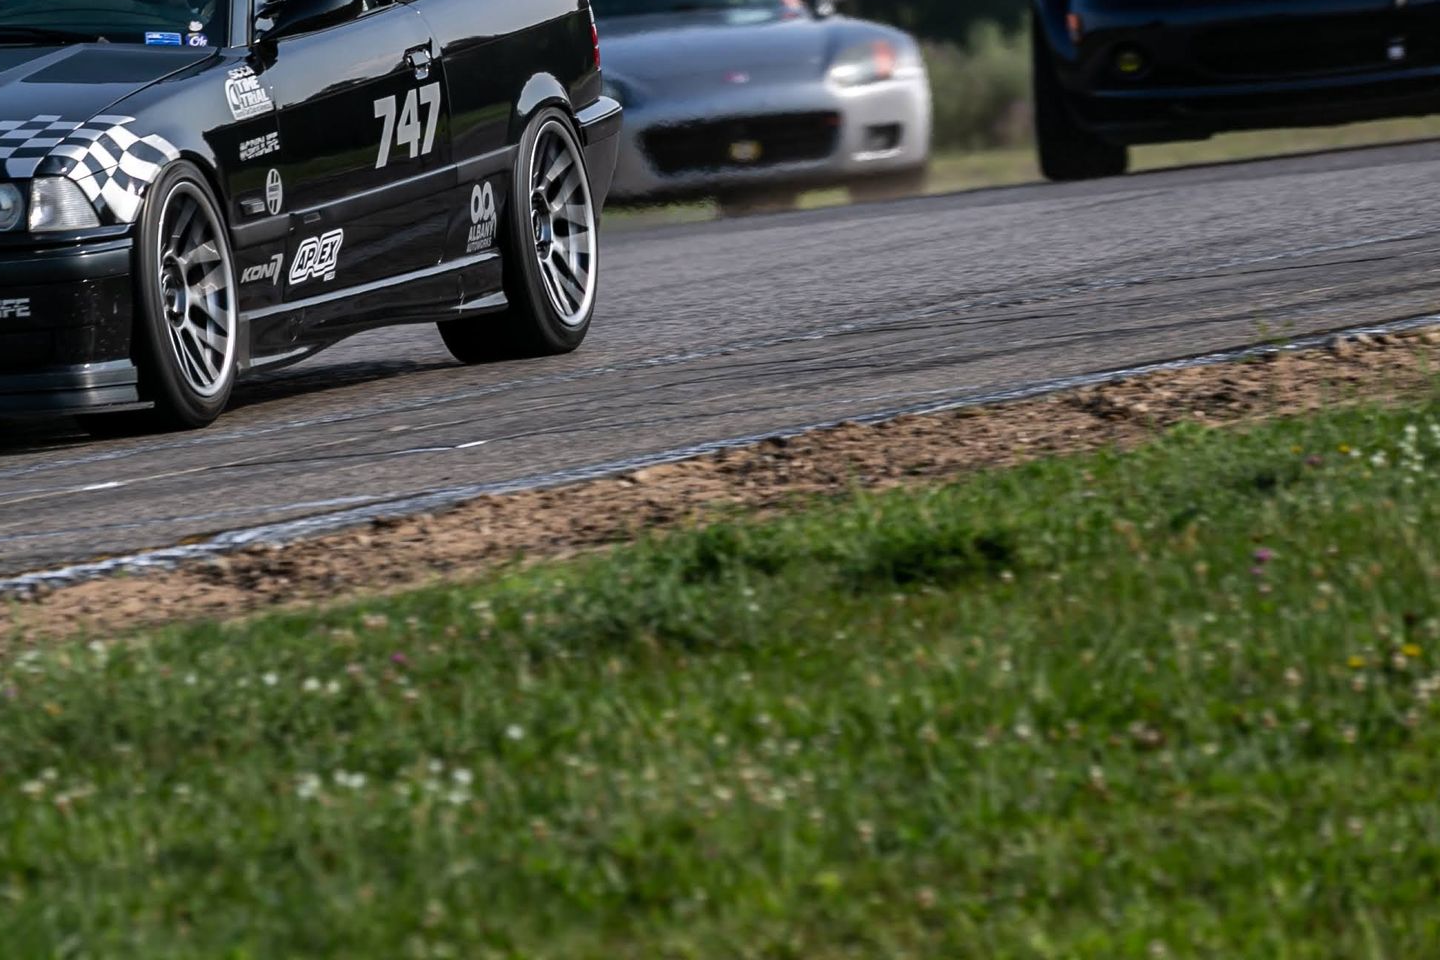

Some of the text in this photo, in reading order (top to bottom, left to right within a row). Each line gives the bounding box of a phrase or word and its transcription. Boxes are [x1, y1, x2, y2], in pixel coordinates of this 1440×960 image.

[235, 75, 260, 93] TIME
[240, 88, 269, 108] TRIAL
[374, 81, 441, 169] 747
[467, 219, 494, 243] ALBANY
[292, 233, 341, 280] APEX
